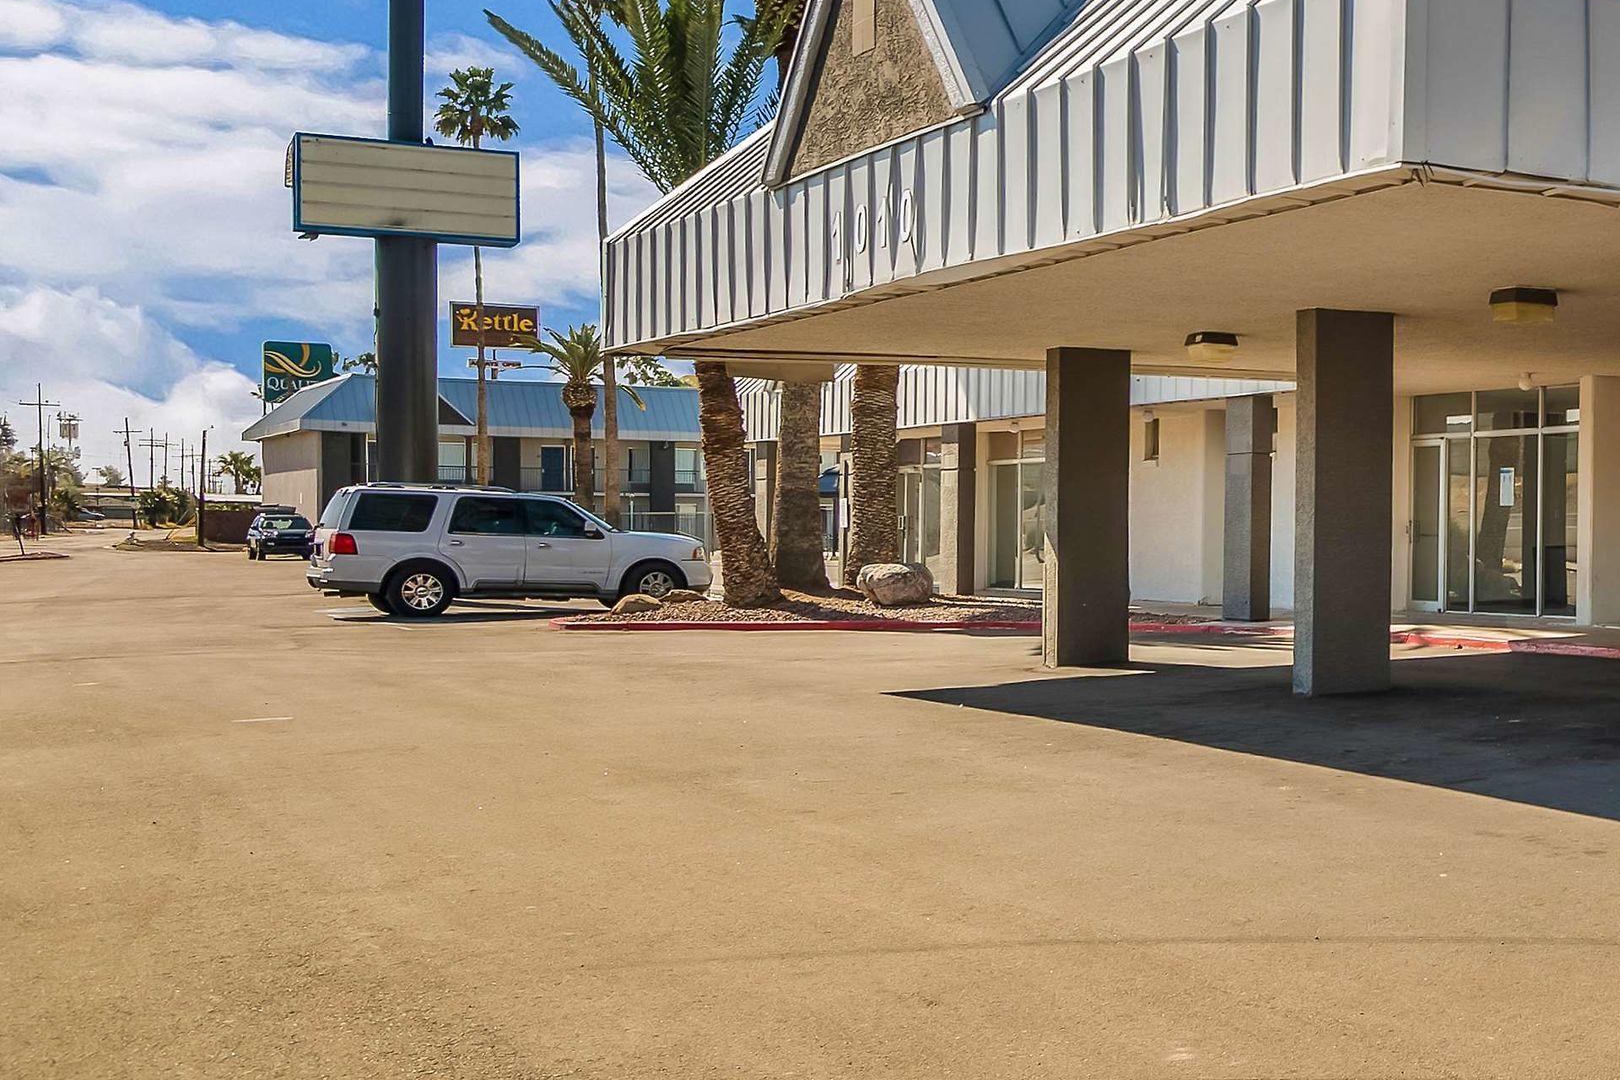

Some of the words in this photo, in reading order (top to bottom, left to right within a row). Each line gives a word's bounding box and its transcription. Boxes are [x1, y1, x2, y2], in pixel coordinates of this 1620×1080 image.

[832, 188, 914, 262] 1010
[455, 307, 534, 332] Kettle
[266, 376, 319, 391] QUAL
